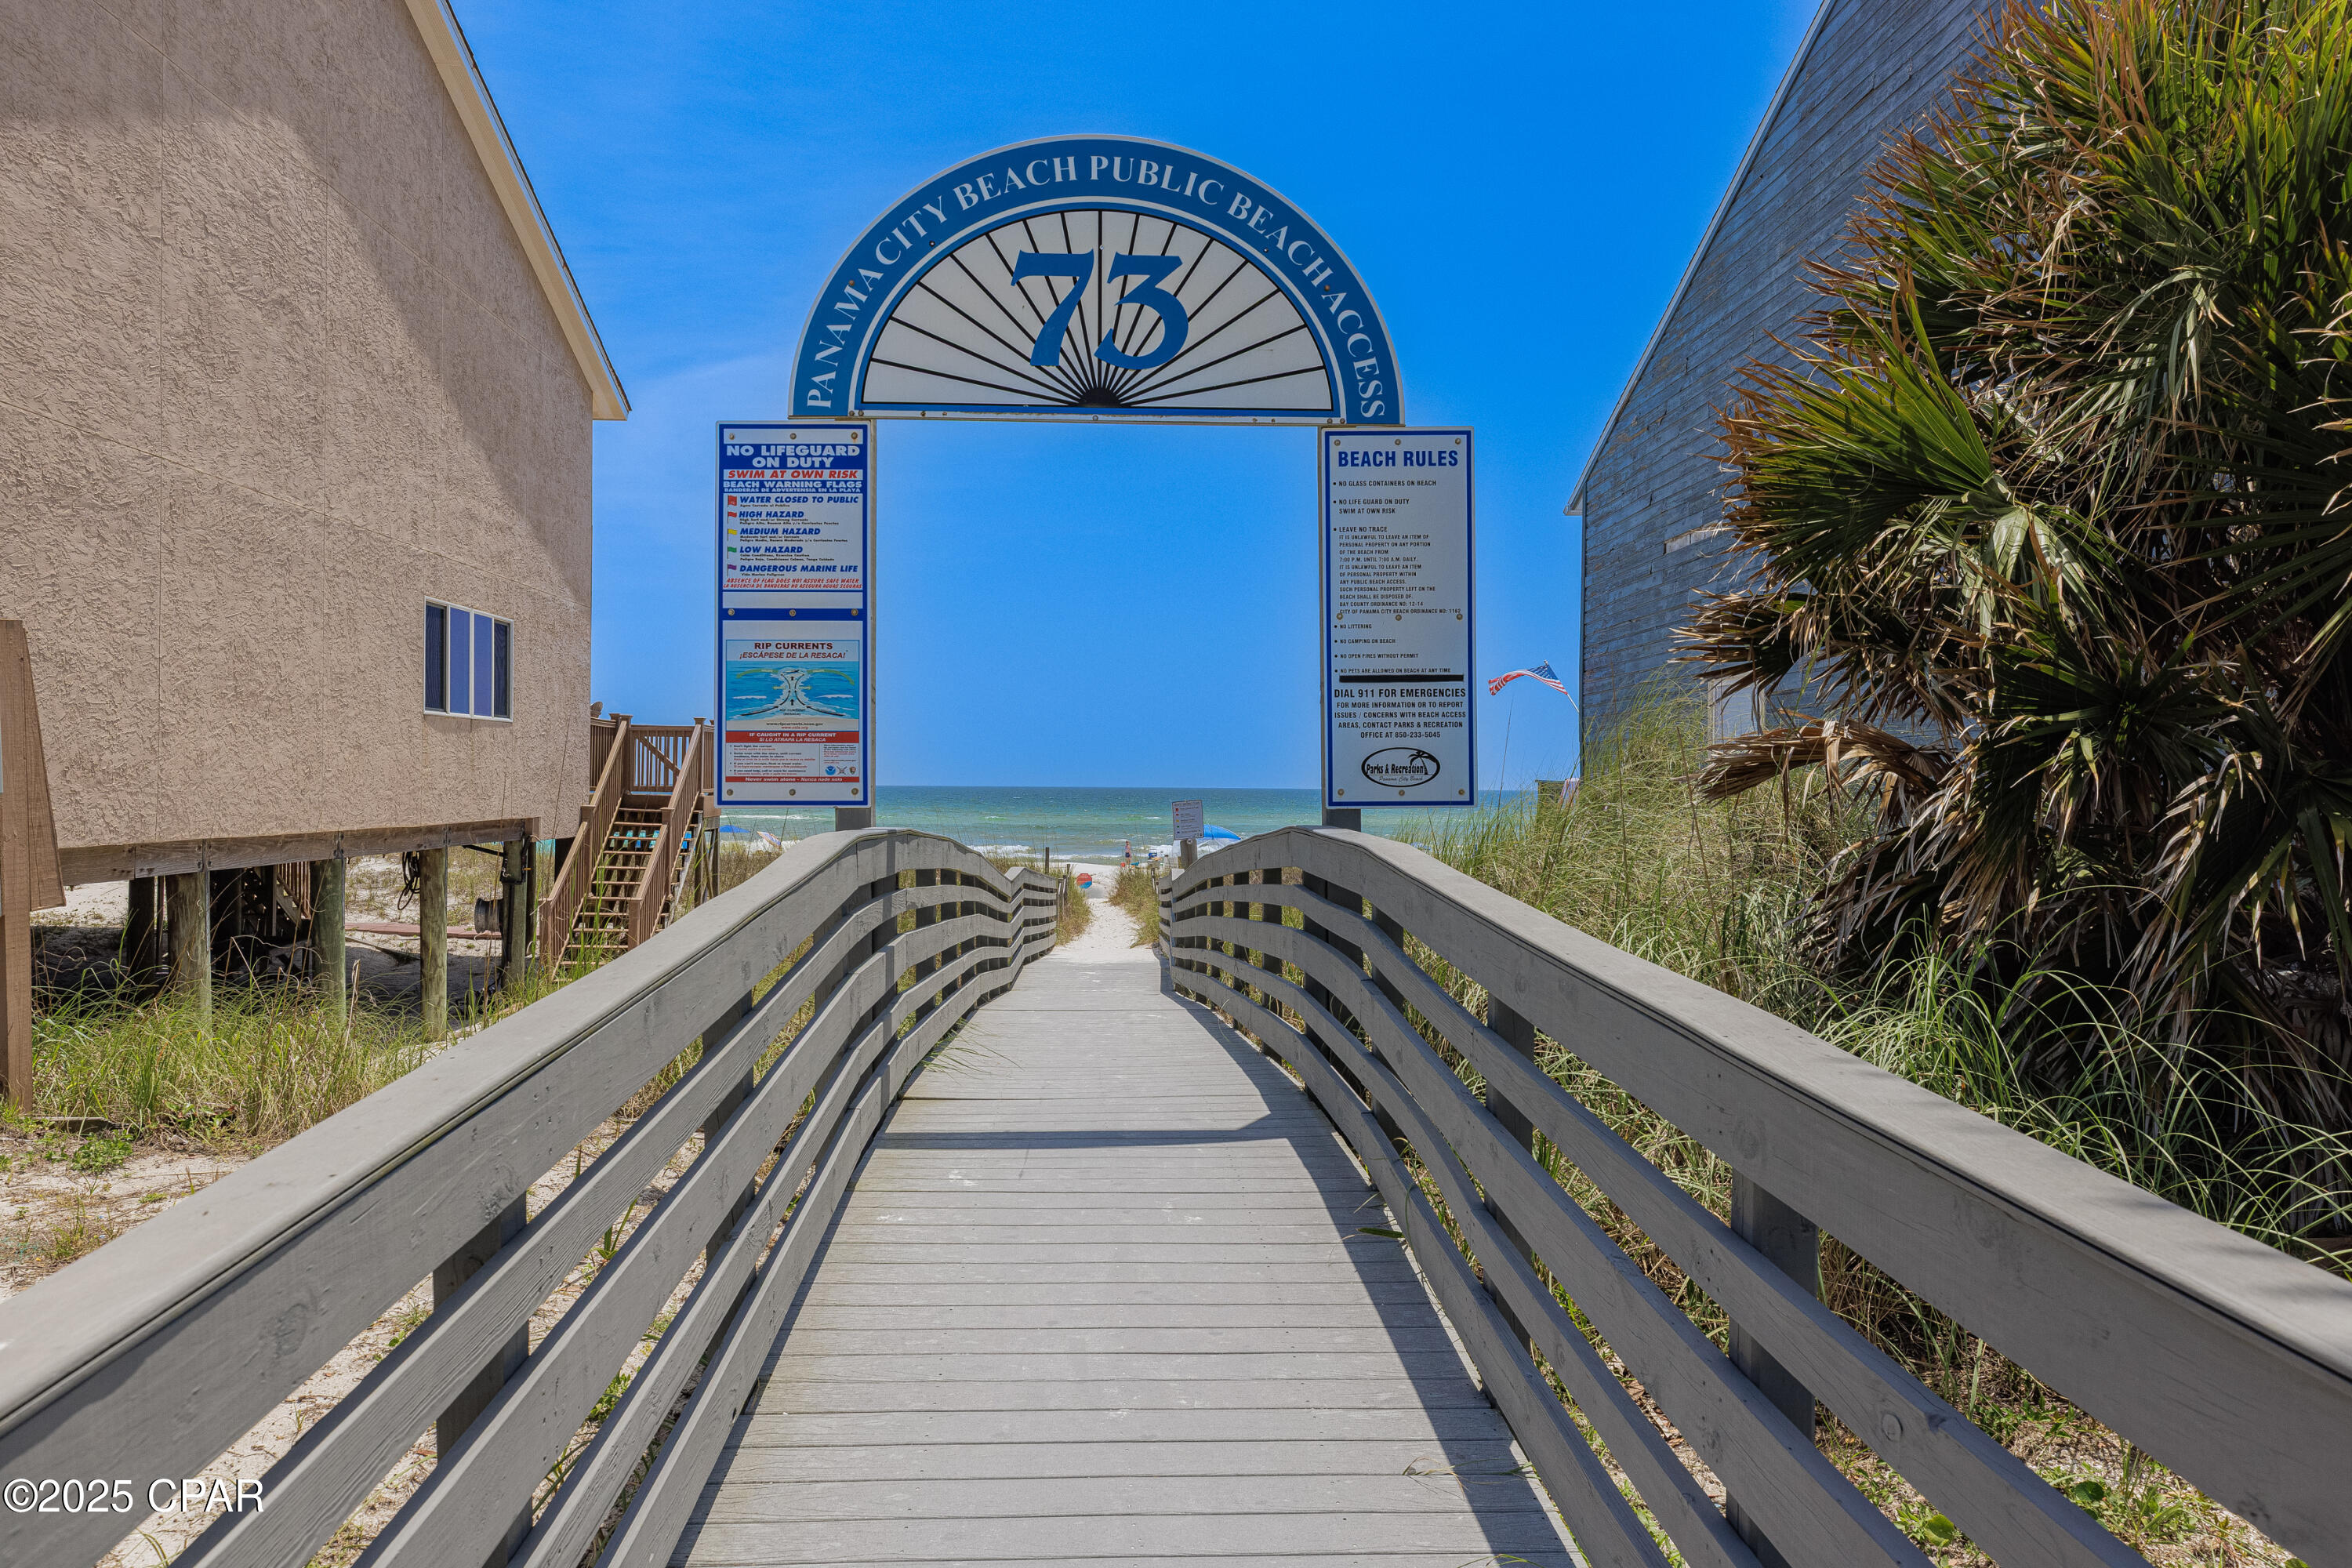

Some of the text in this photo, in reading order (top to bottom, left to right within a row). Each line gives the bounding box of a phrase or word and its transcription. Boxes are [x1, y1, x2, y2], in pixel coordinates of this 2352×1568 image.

[807, 155, 1385, 419] PANAMA CITY BEACH PUBLIC BEACH ACCESS
[1011, 249, 1189, 370] 73
[726, 445, 860, 456] NO LIFEGUARD
[752, 457, 833, 468] ON DUTY
[1338, 450, 1458, 467] BEACH RULES
[728, 470, 858, 479] SWIM AT OWN RISK
[1334, 688, 1465, 698] DIAL 911 FOR EMERGENCIES
[1367, 764, 1425, 775] Parks & Recreation
